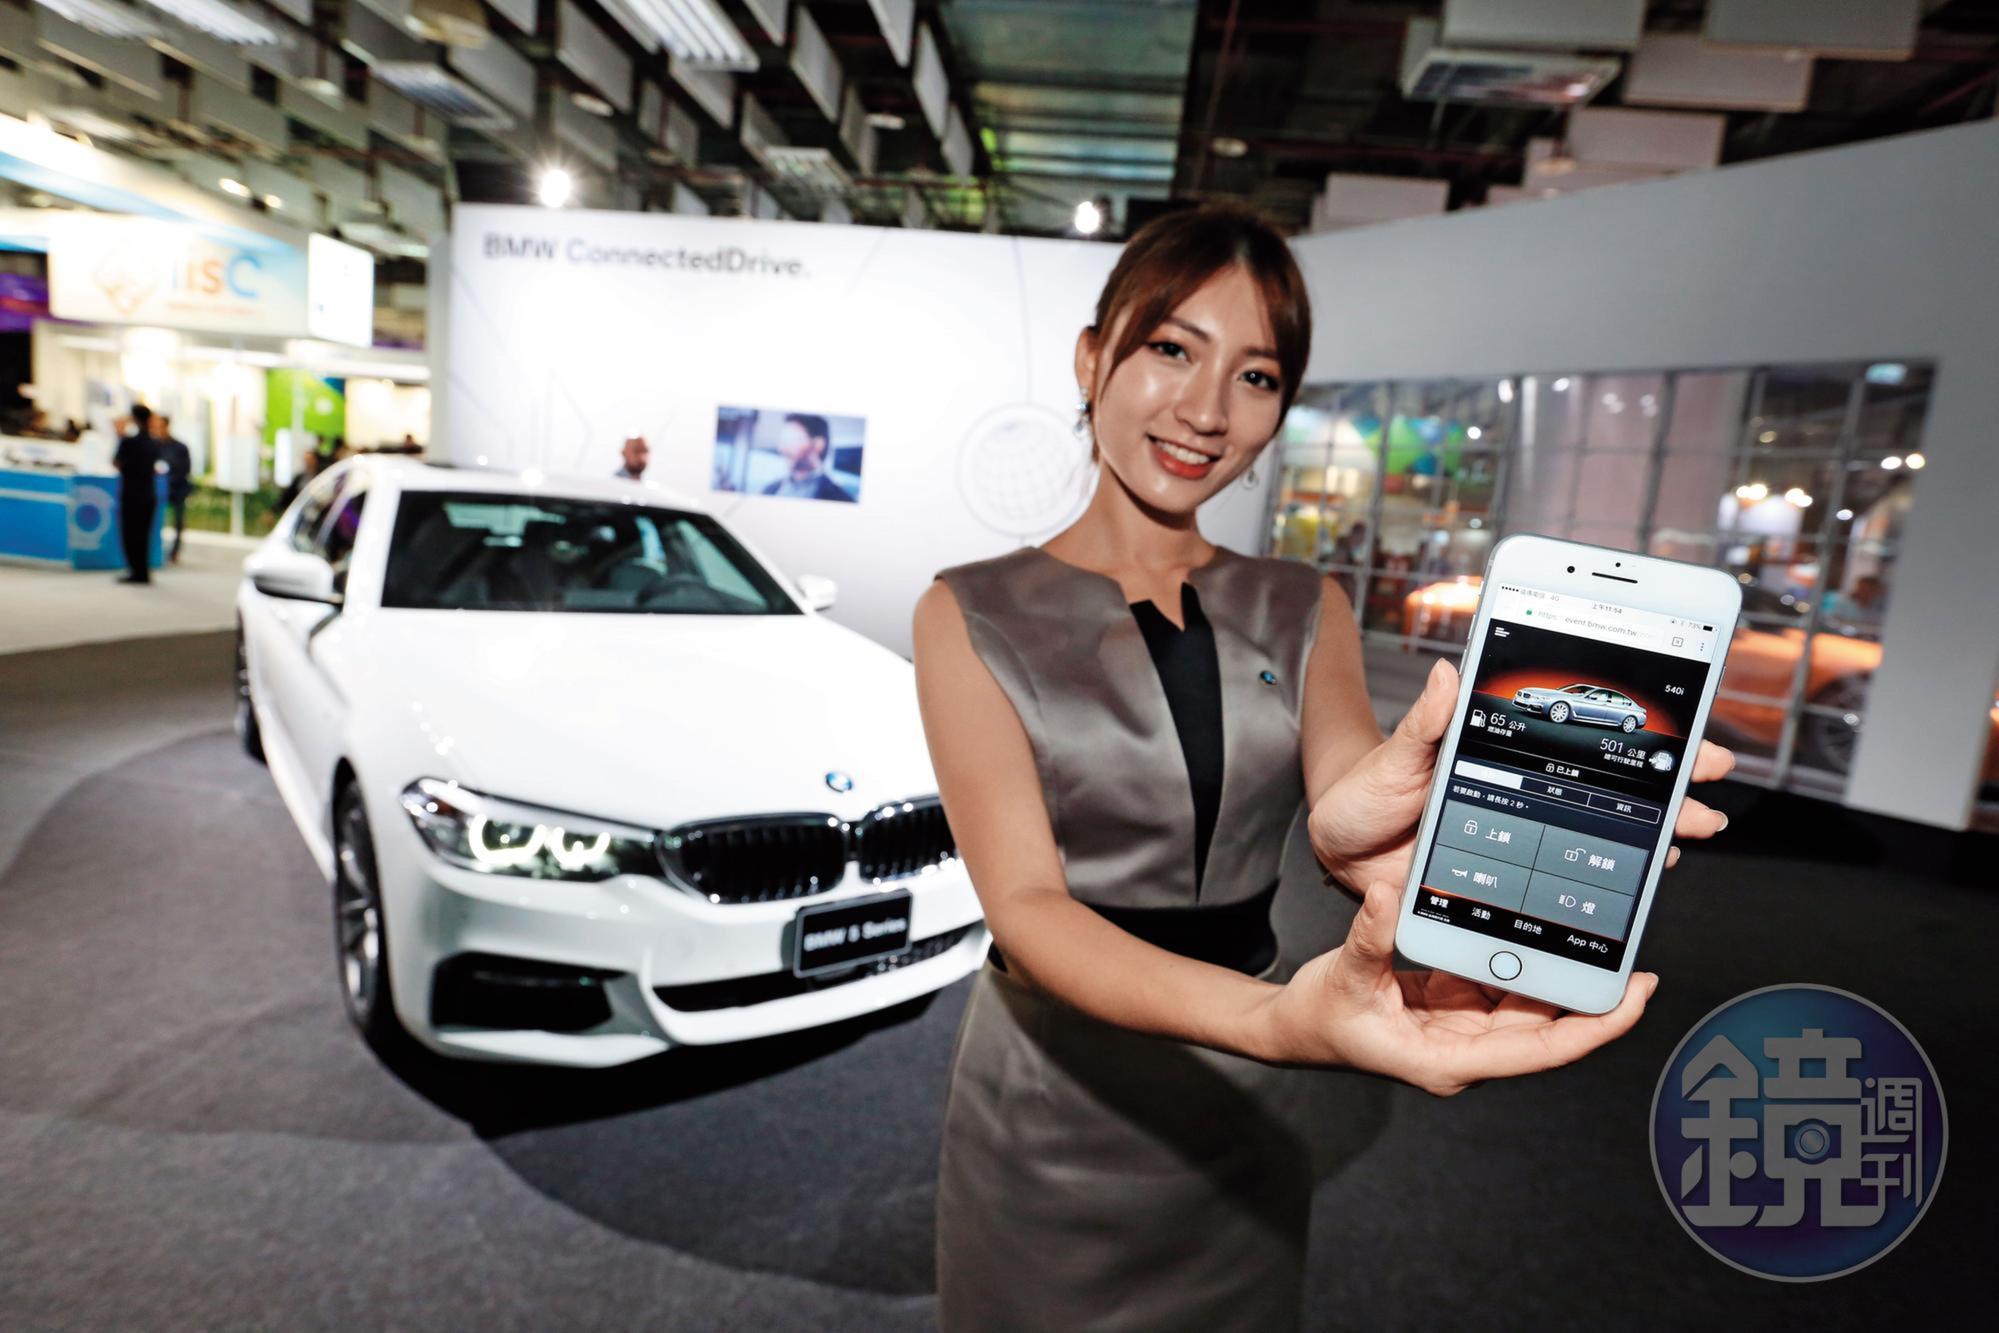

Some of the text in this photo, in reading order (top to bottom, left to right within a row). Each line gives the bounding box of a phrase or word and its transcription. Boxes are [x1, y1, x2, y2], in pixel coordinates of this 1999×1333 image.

[483, 232, 556, 259] BMW
[1664, 684, 1685, 696] 540i
[1490, 712, 1527, 732] 65 公升
[1599, 737, 1647, 760] 501 公里
[1556, 765, 1580, 779] 已上鎖
[1616, 802, 1632, 814] 資訊
[1485, 827, 1512, 845] 上鎖
[1588, 854, 1616, 872] 解鎖
[1472, 871, 1498, 889] 喇叭
[1429, 895, 1450, 909] 管理
[1580, 900, 1597, 916] 燈
[1471, 907, 1491, 921] 活動
[1513, 919, 1543, 936] 目的地
[1566, 933, 1609, 954] App 中心
